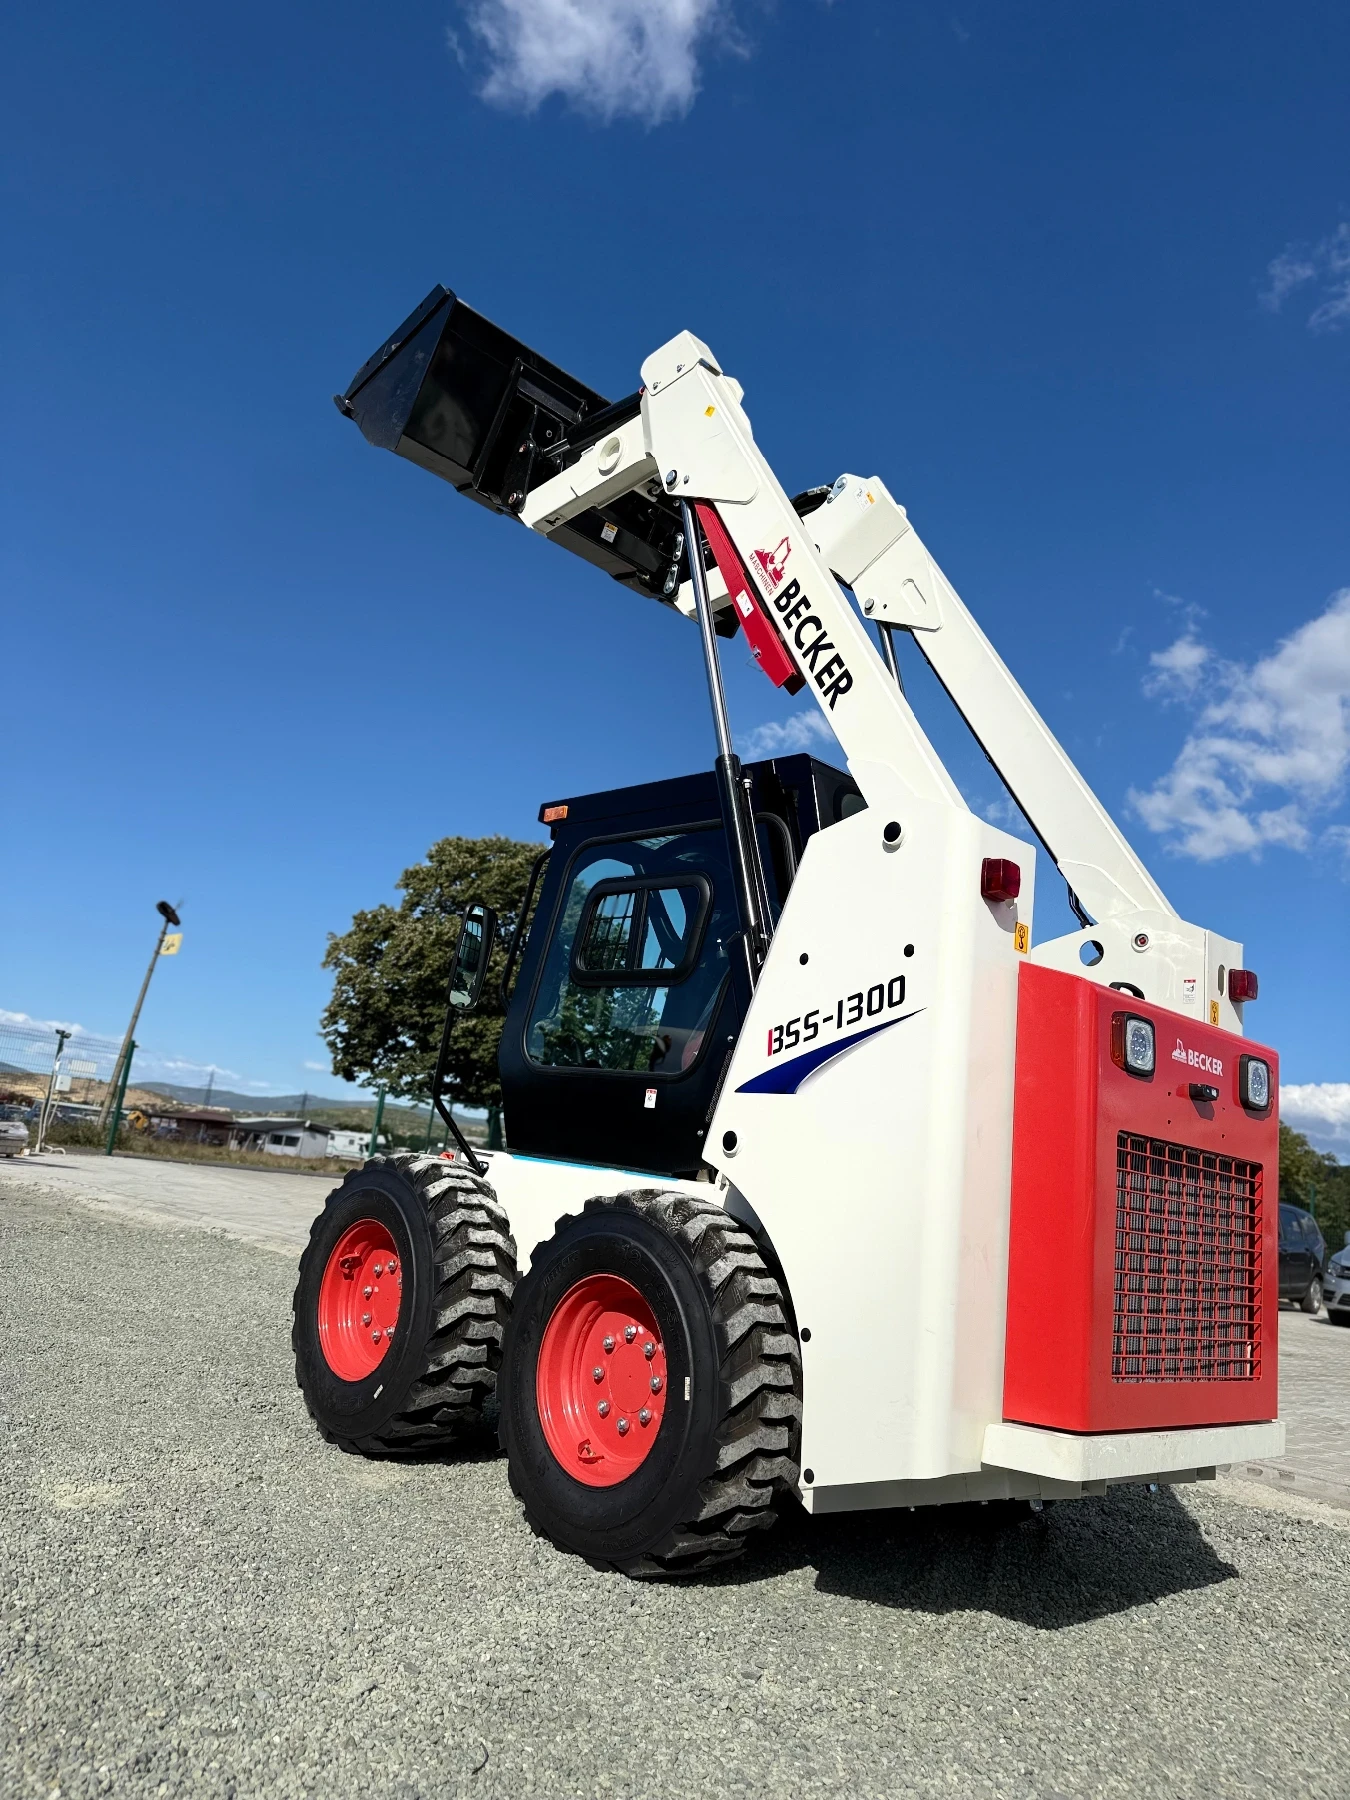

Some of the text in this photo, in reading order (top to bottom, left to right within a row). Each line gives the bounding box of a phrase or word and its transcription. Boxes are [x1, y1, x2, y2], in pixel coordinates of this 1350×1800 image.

[773, 578, 854, 711] BECKER
[767, 974, 906, 1057] BSS-1300
[1187, 1048, 1224, 1077] BECKER
